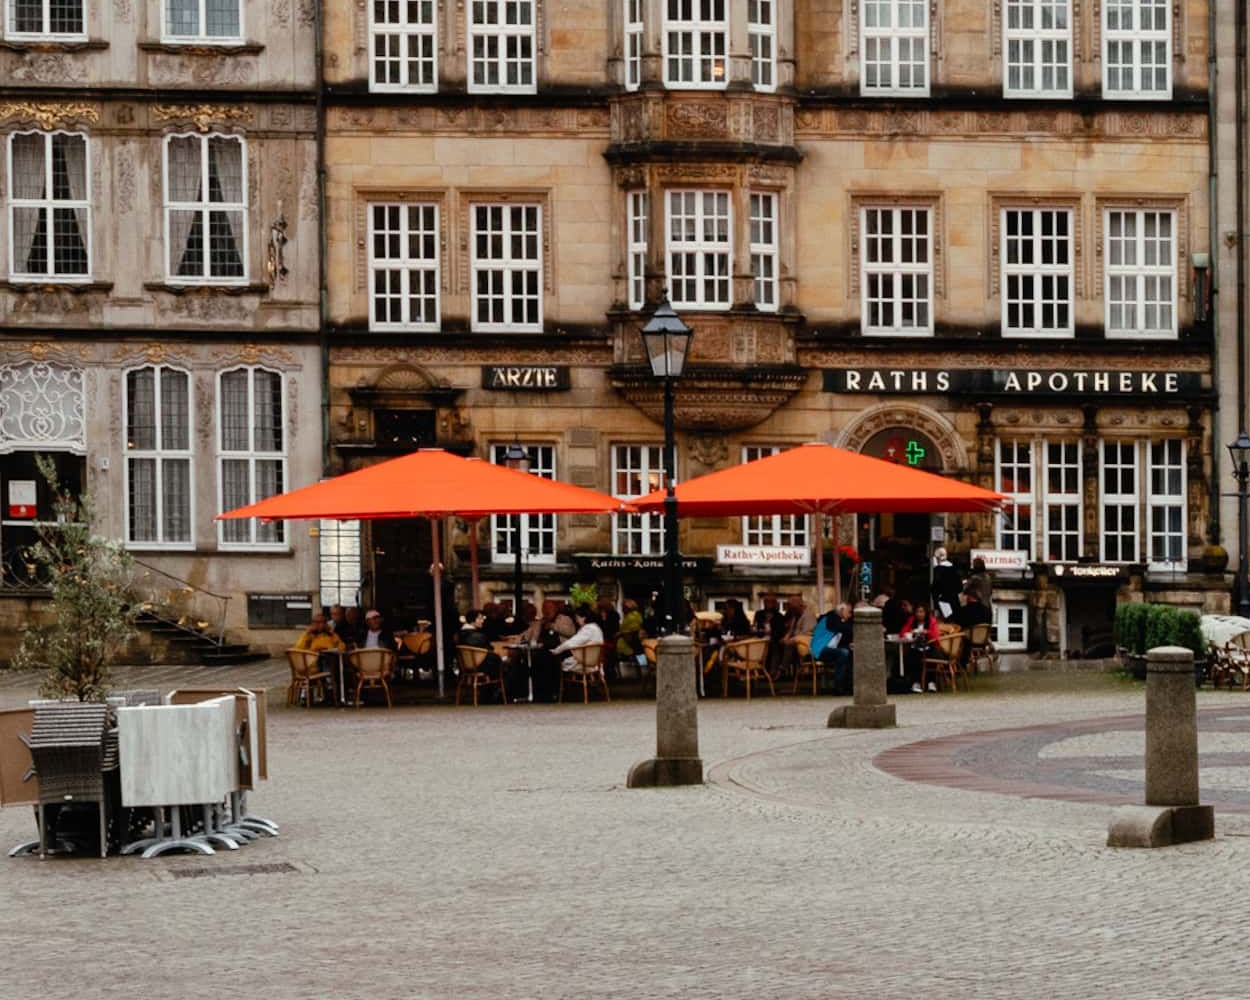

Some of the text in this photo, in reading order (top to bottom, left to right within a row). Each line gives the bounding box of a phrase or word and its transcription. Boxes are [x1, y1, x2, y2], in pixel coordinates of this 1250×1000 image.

[492, 367, 558, 387] ÄRZTE
[846, 370, 1179, 393] RATHS APOTHEKE
